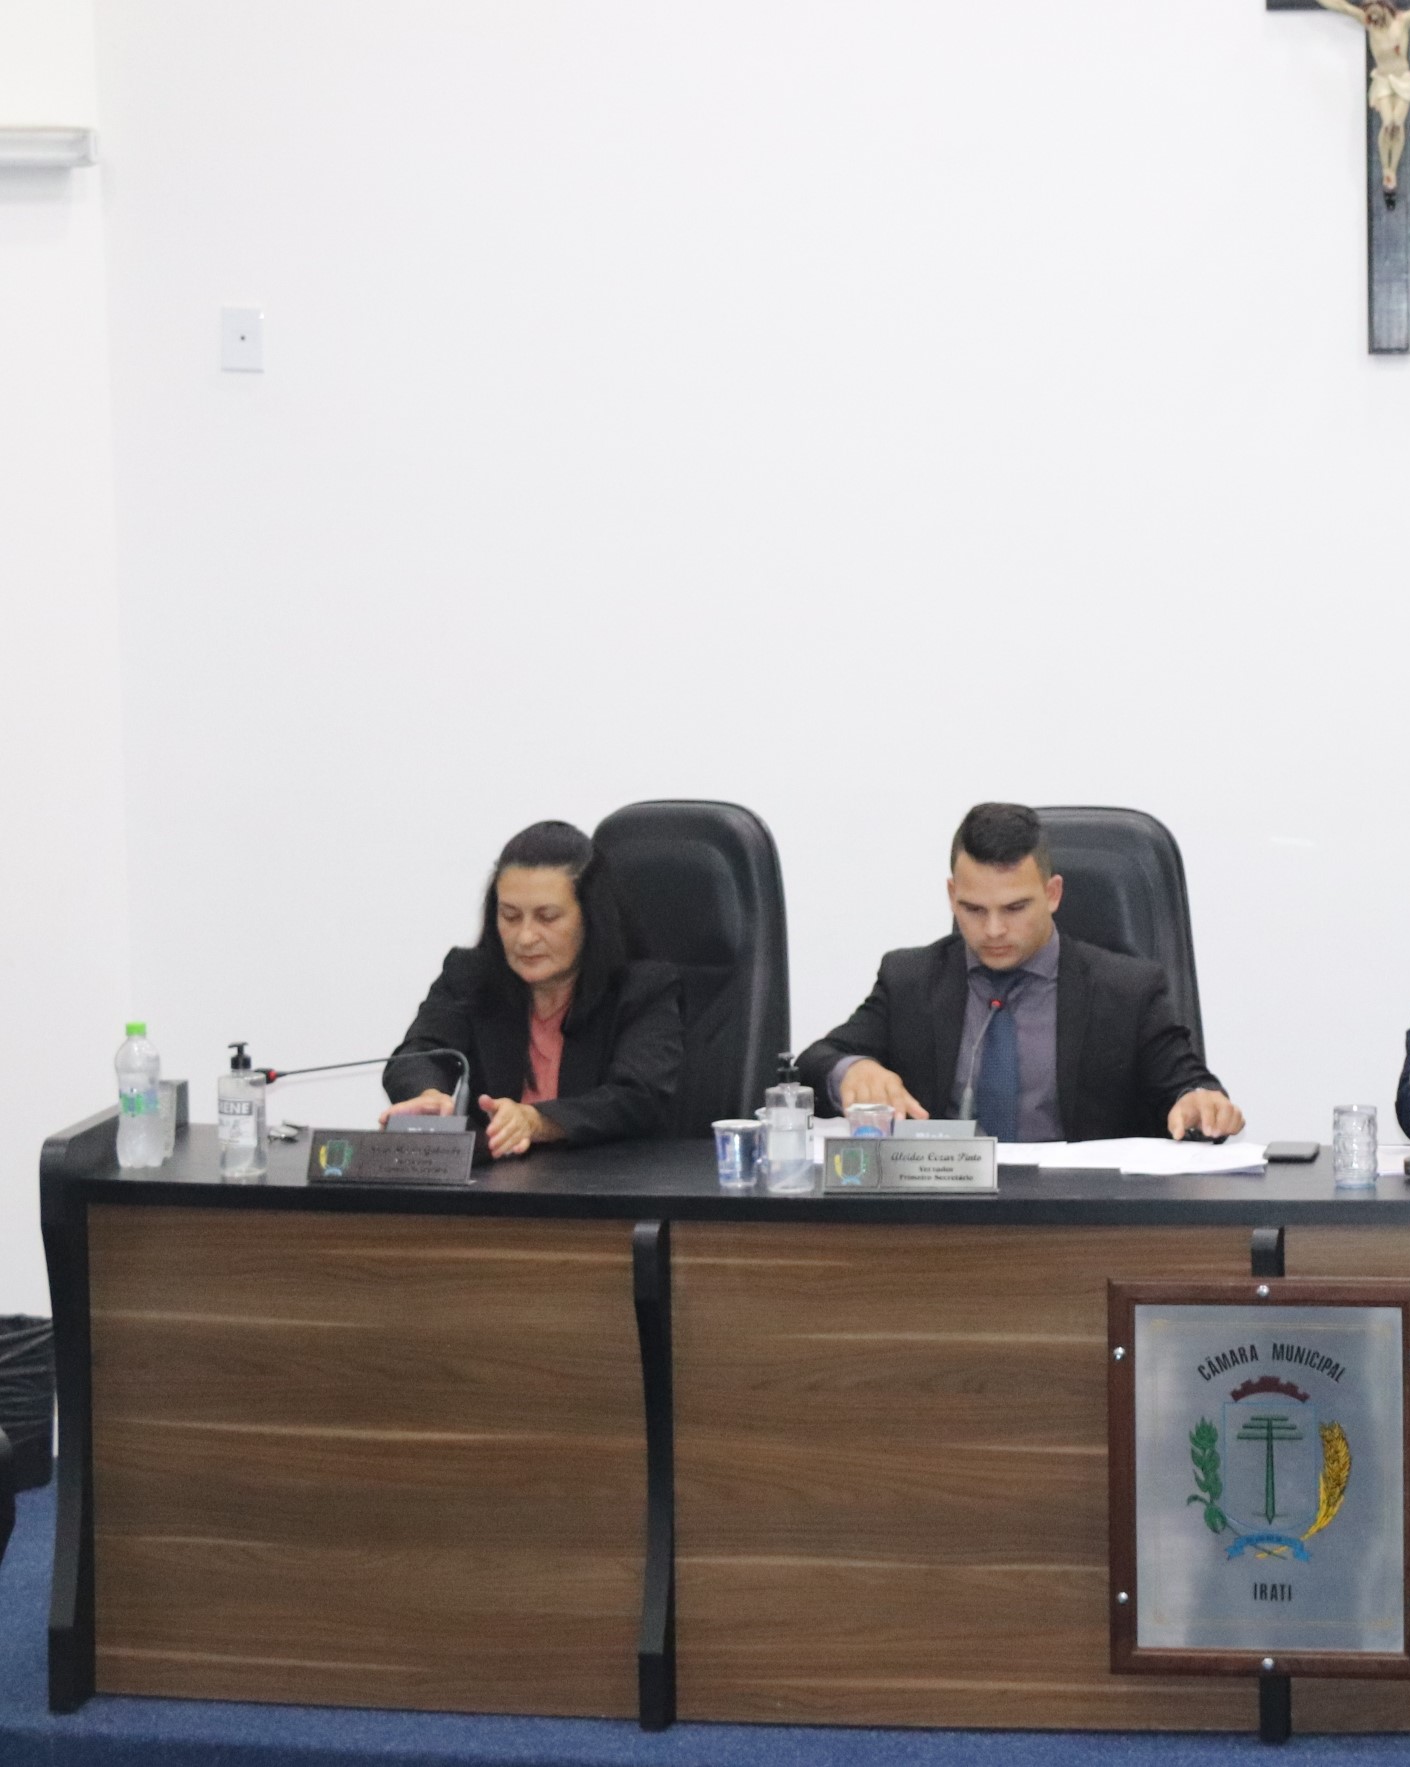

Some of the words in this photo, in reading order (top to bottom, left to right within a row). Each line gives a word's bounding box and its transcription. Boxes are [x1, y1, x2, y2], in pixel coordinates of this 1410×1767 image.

[1198, 1344, 1259, 1381] CÂMARA
[1271, 1342, 1346, 1383] MUNICIPAL
[1253, 1583, 1292, 1601] IRATI
